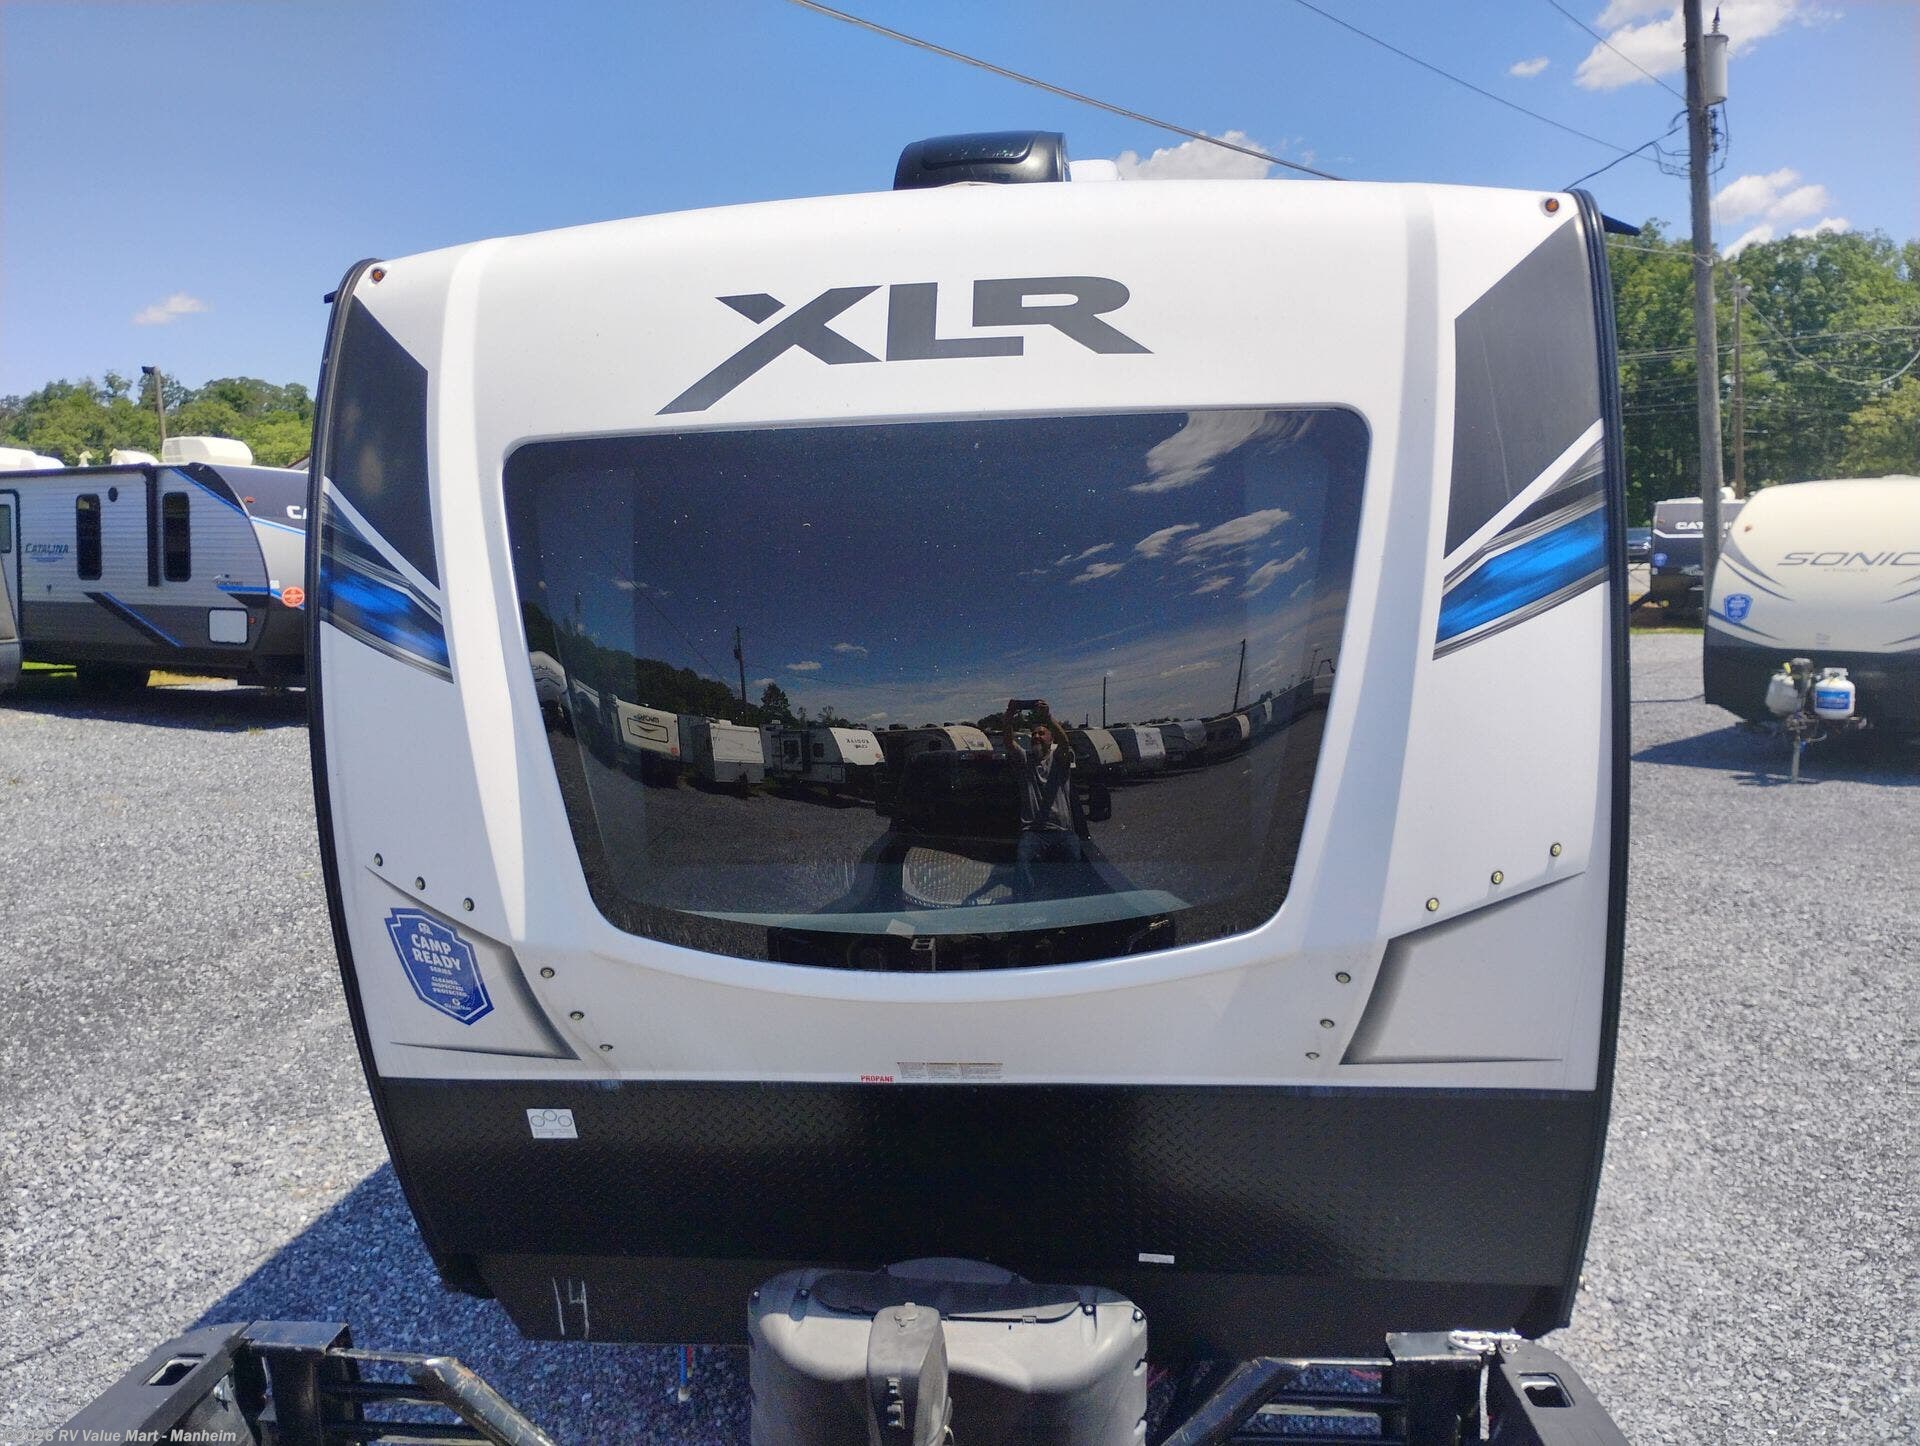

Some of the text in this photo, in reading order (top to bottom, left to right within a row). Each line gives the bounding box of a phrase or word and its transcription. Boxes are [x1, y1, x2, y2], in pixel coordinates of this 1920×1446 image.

[655, 275, 1155, 416] XLR
[1777, 551, 1920, 566] SONIC
[410, 933, 452, 955] CAMP
[412, 948, 462, 972] READY
[860, 1074, 894, 1082] PROPANE
[552, 1276, 590, 1339] 14
